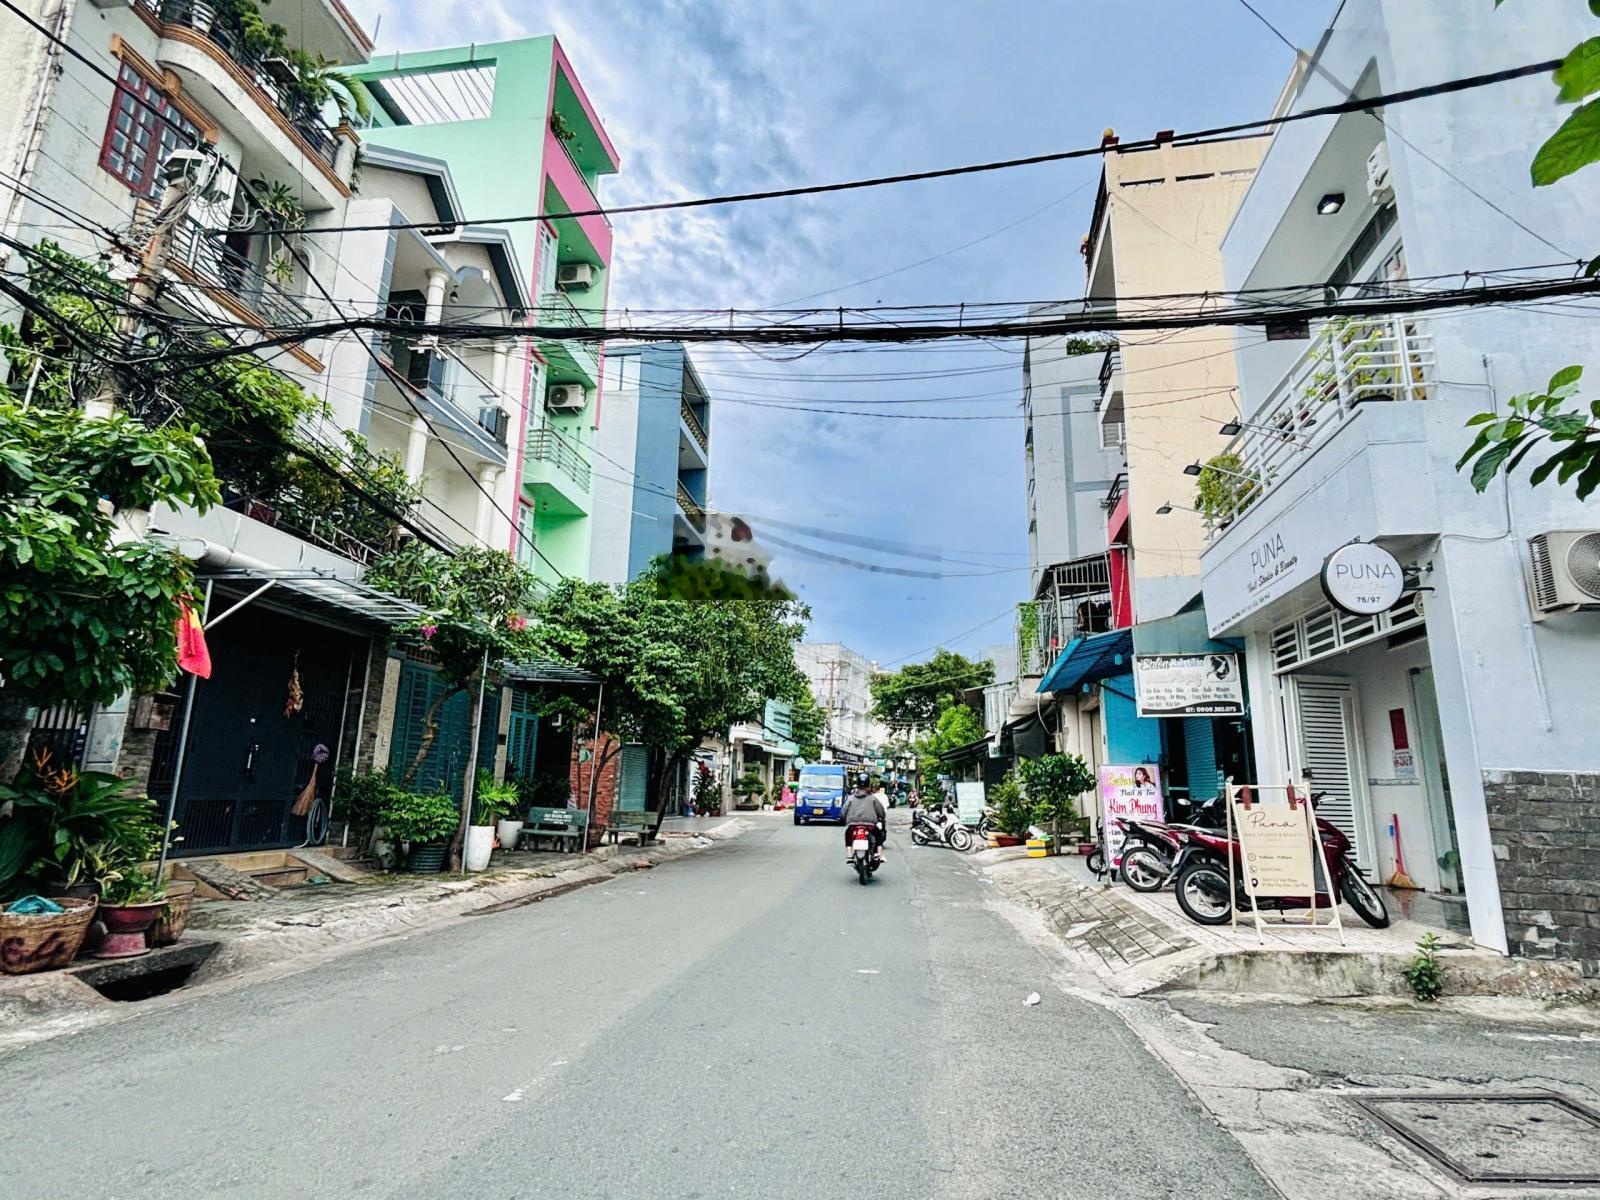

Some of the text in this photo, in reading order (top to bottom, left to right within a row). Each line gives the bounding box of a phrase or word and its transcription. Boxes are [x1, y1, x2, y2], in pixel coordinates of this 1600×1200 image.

[1250, 532, 1285, 573] PUNA
[1336, 563, 1396, 580] PUNA
[1108, 798, 1128, 814] Kim
[1247, 811, 1297, 828] Puna
